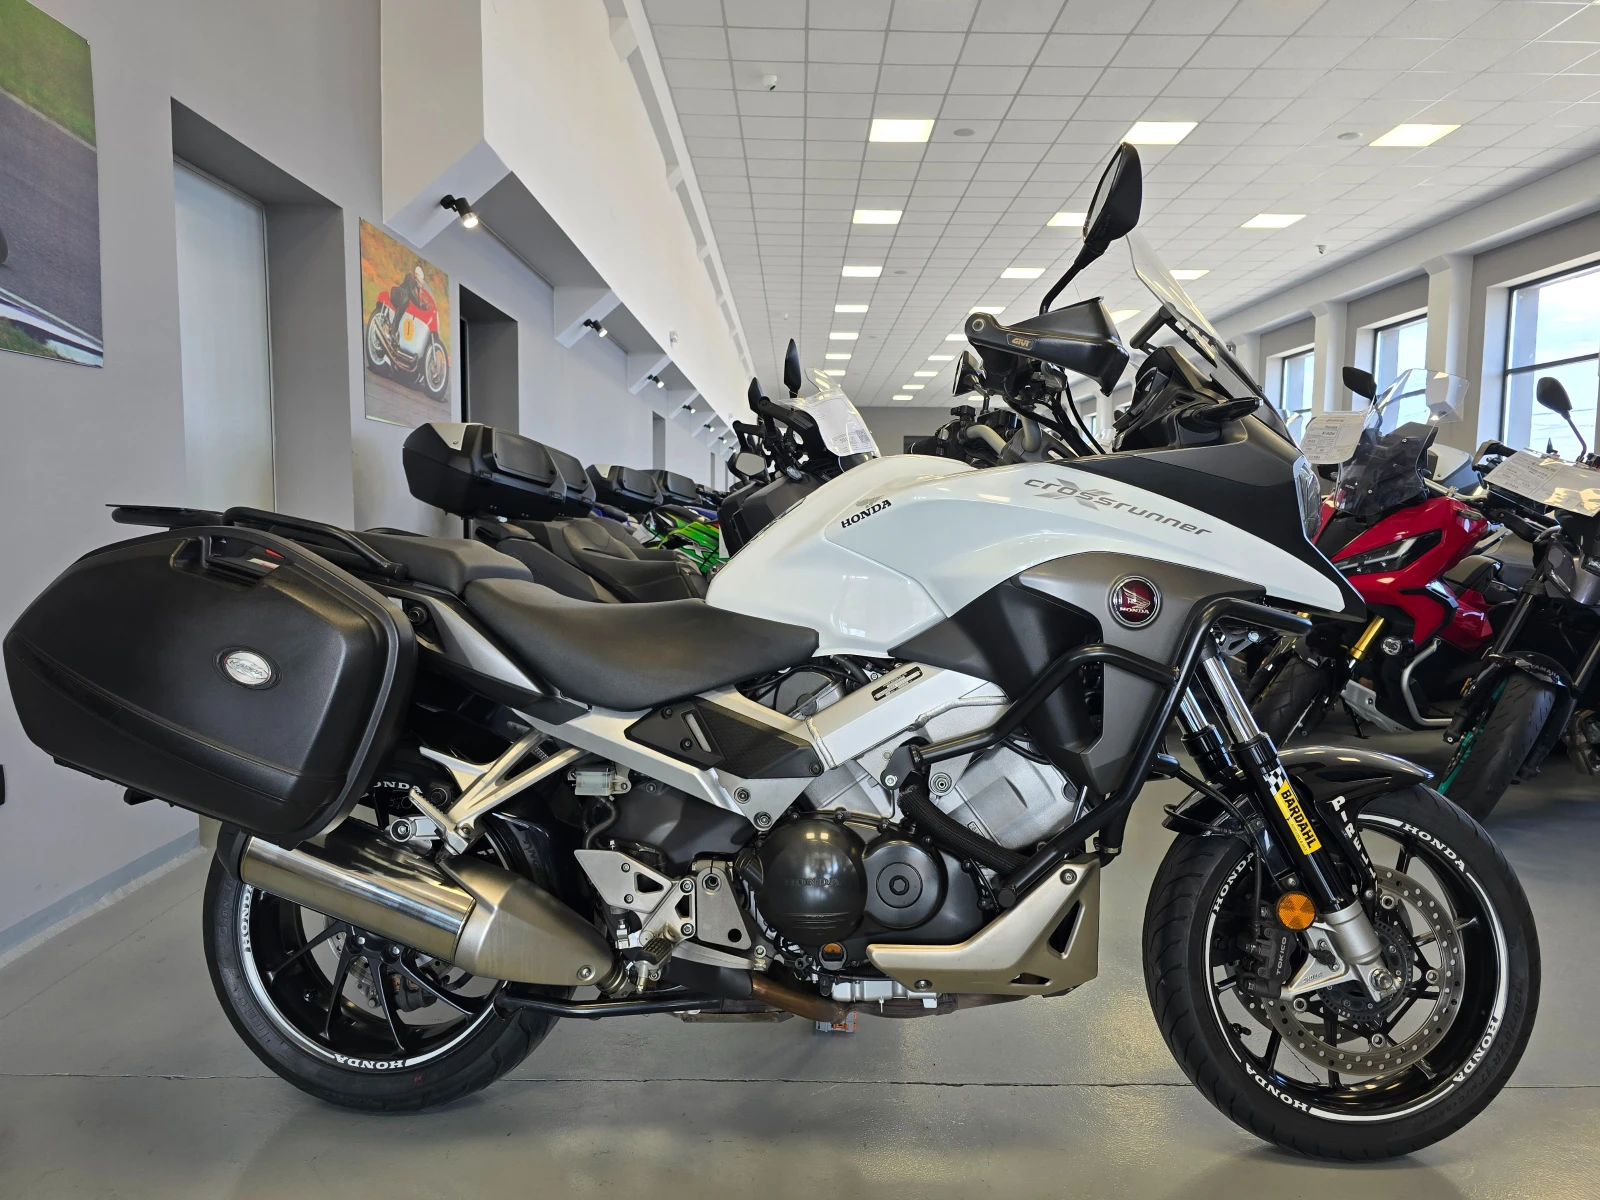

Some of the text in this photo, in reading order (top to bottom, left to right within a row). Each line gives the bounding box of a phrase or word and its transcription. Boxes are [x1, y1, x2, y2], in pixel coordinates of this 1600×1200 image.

[1011, 337, 1031, 347] GIVI
[840, 499, 892, 529] HONDA
[1023, 479, 1212, 535] crossrunner
[1119, 606, 1150, 615] HONDA
[1281, 789, 1316, 849] BARDAHL
[1402, 823, 1466, 872] HONDA
[785, 878, 841, 887] HONDA
[1276, 936, 1287, 976] TOKICO
[334, 1053, 404, 1069] HONDA
[1453, 1016, 1500, 1082] HONDA
[1245, 1062, 1308, 1112] HONDA
